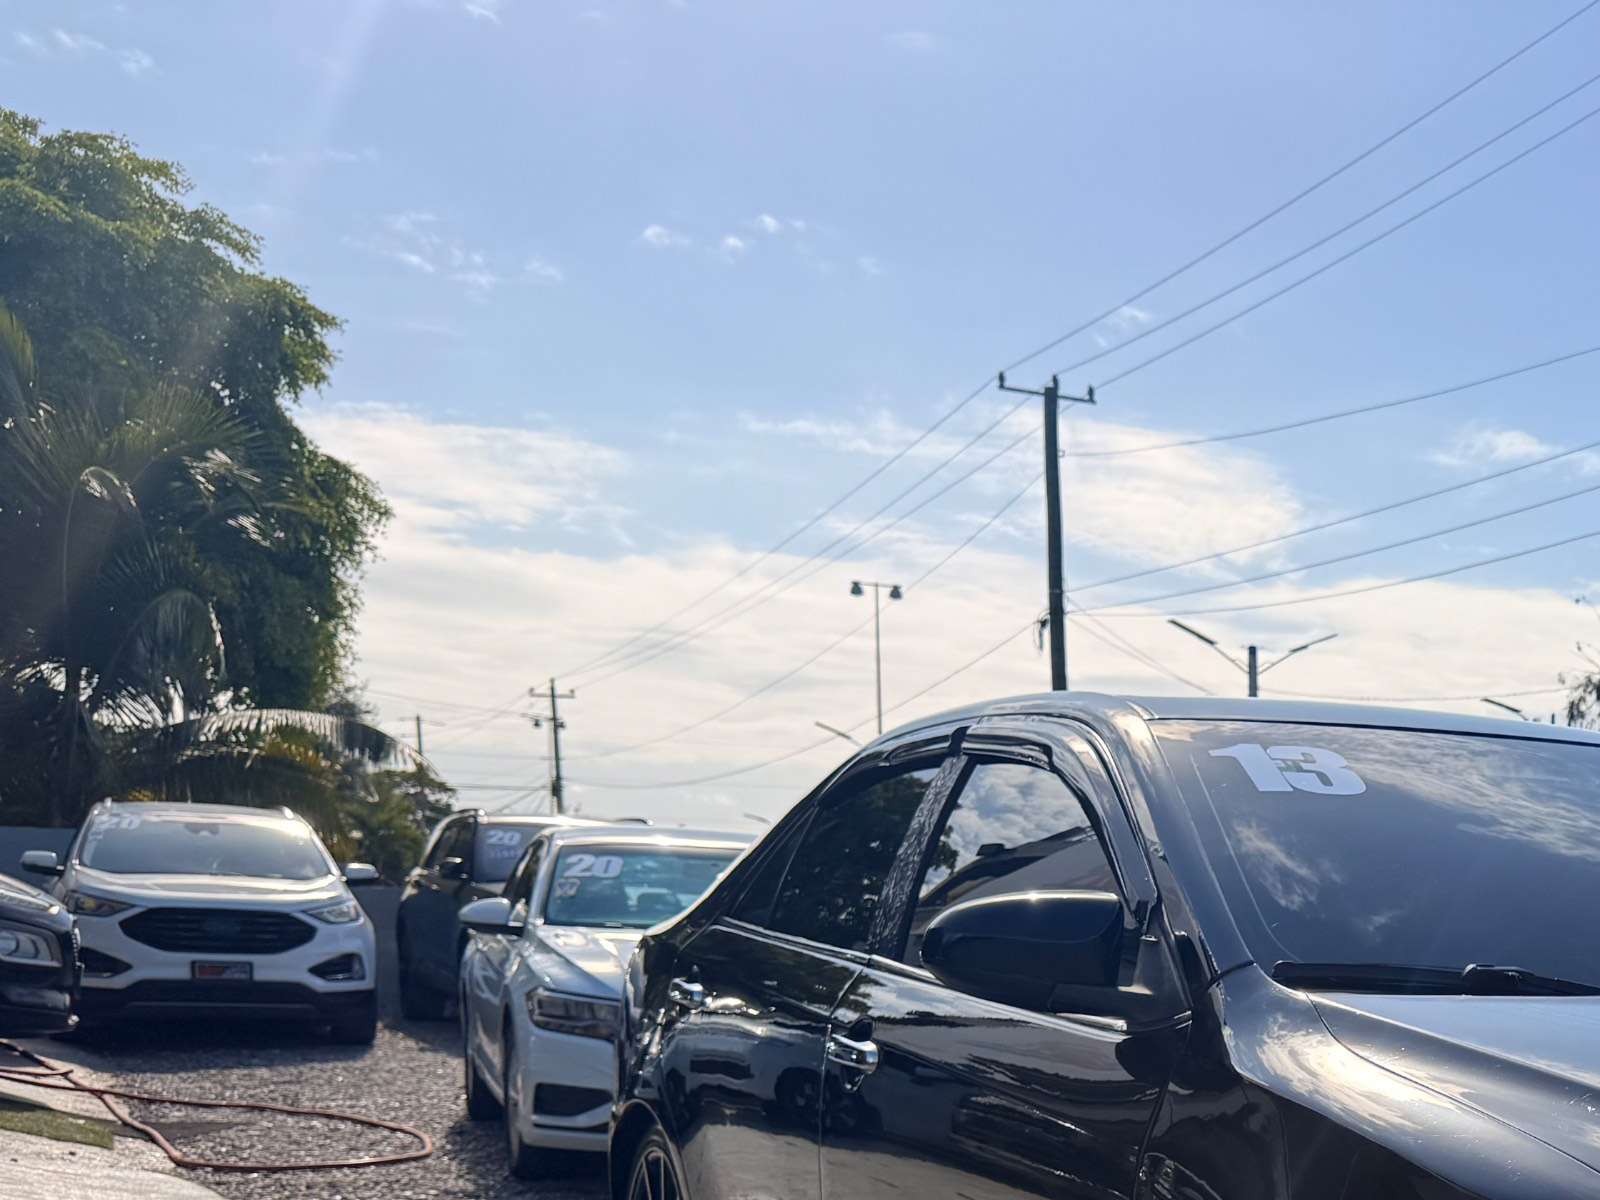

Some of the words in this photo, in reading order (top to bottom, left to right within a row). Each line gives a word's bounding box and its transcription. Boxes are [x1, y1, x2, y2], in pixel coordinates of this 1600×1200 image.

[1208, 743, 1367, 796] 13
[486, 829, 522, 846] 20
[563, 853, 624, 878] 20
